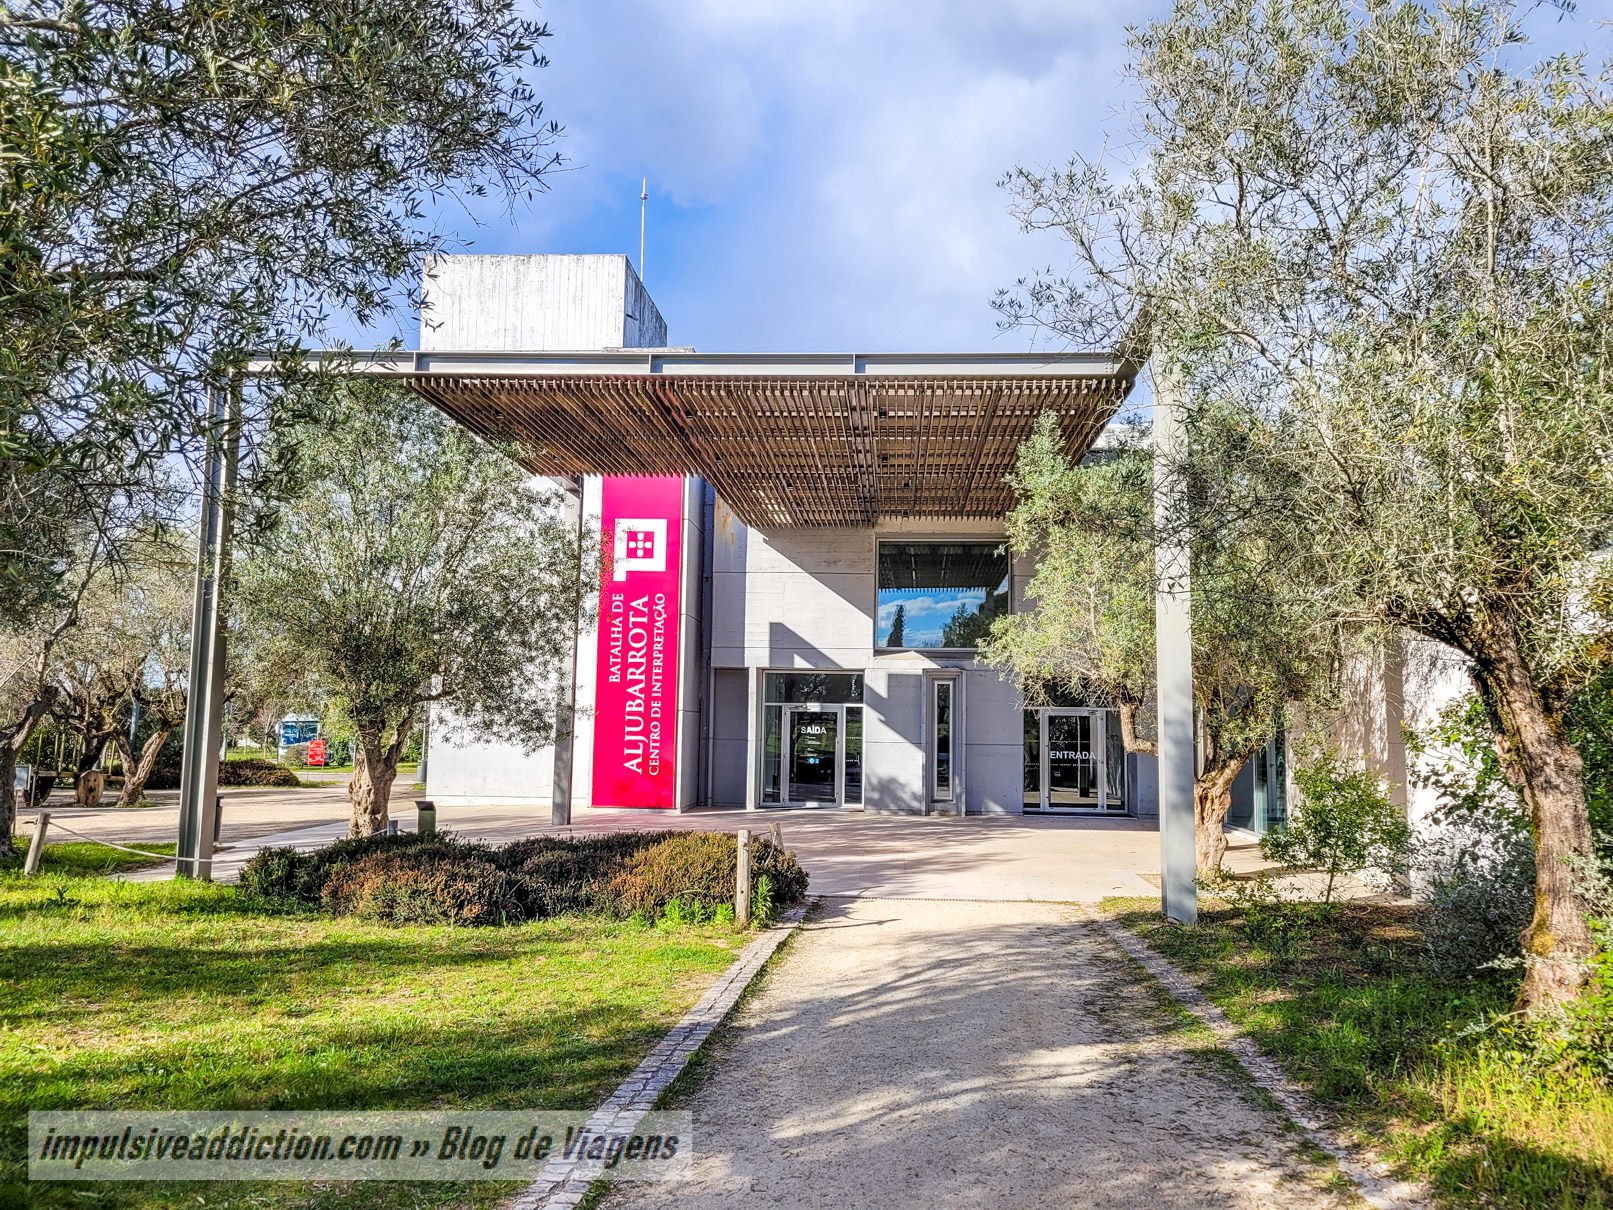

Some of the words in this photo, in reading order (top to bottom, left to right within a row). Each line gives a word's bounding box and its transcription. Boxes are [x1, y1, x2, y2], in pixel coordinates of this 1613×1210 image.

[612, 593, 624, 614] DE
[609, 616, 623, 683] BATALHA
[651, 593, 667, 697] INTERPRETAÇÃO
[623, 595, 649, 775] ALJUBARROTA
[651, 700, 662, 718] DE
[648, 721, 662, 776] CENTRO
[800, 725, 827, 734] SAÍDA
[1050, 750, 1096, 760] ENTRADA
